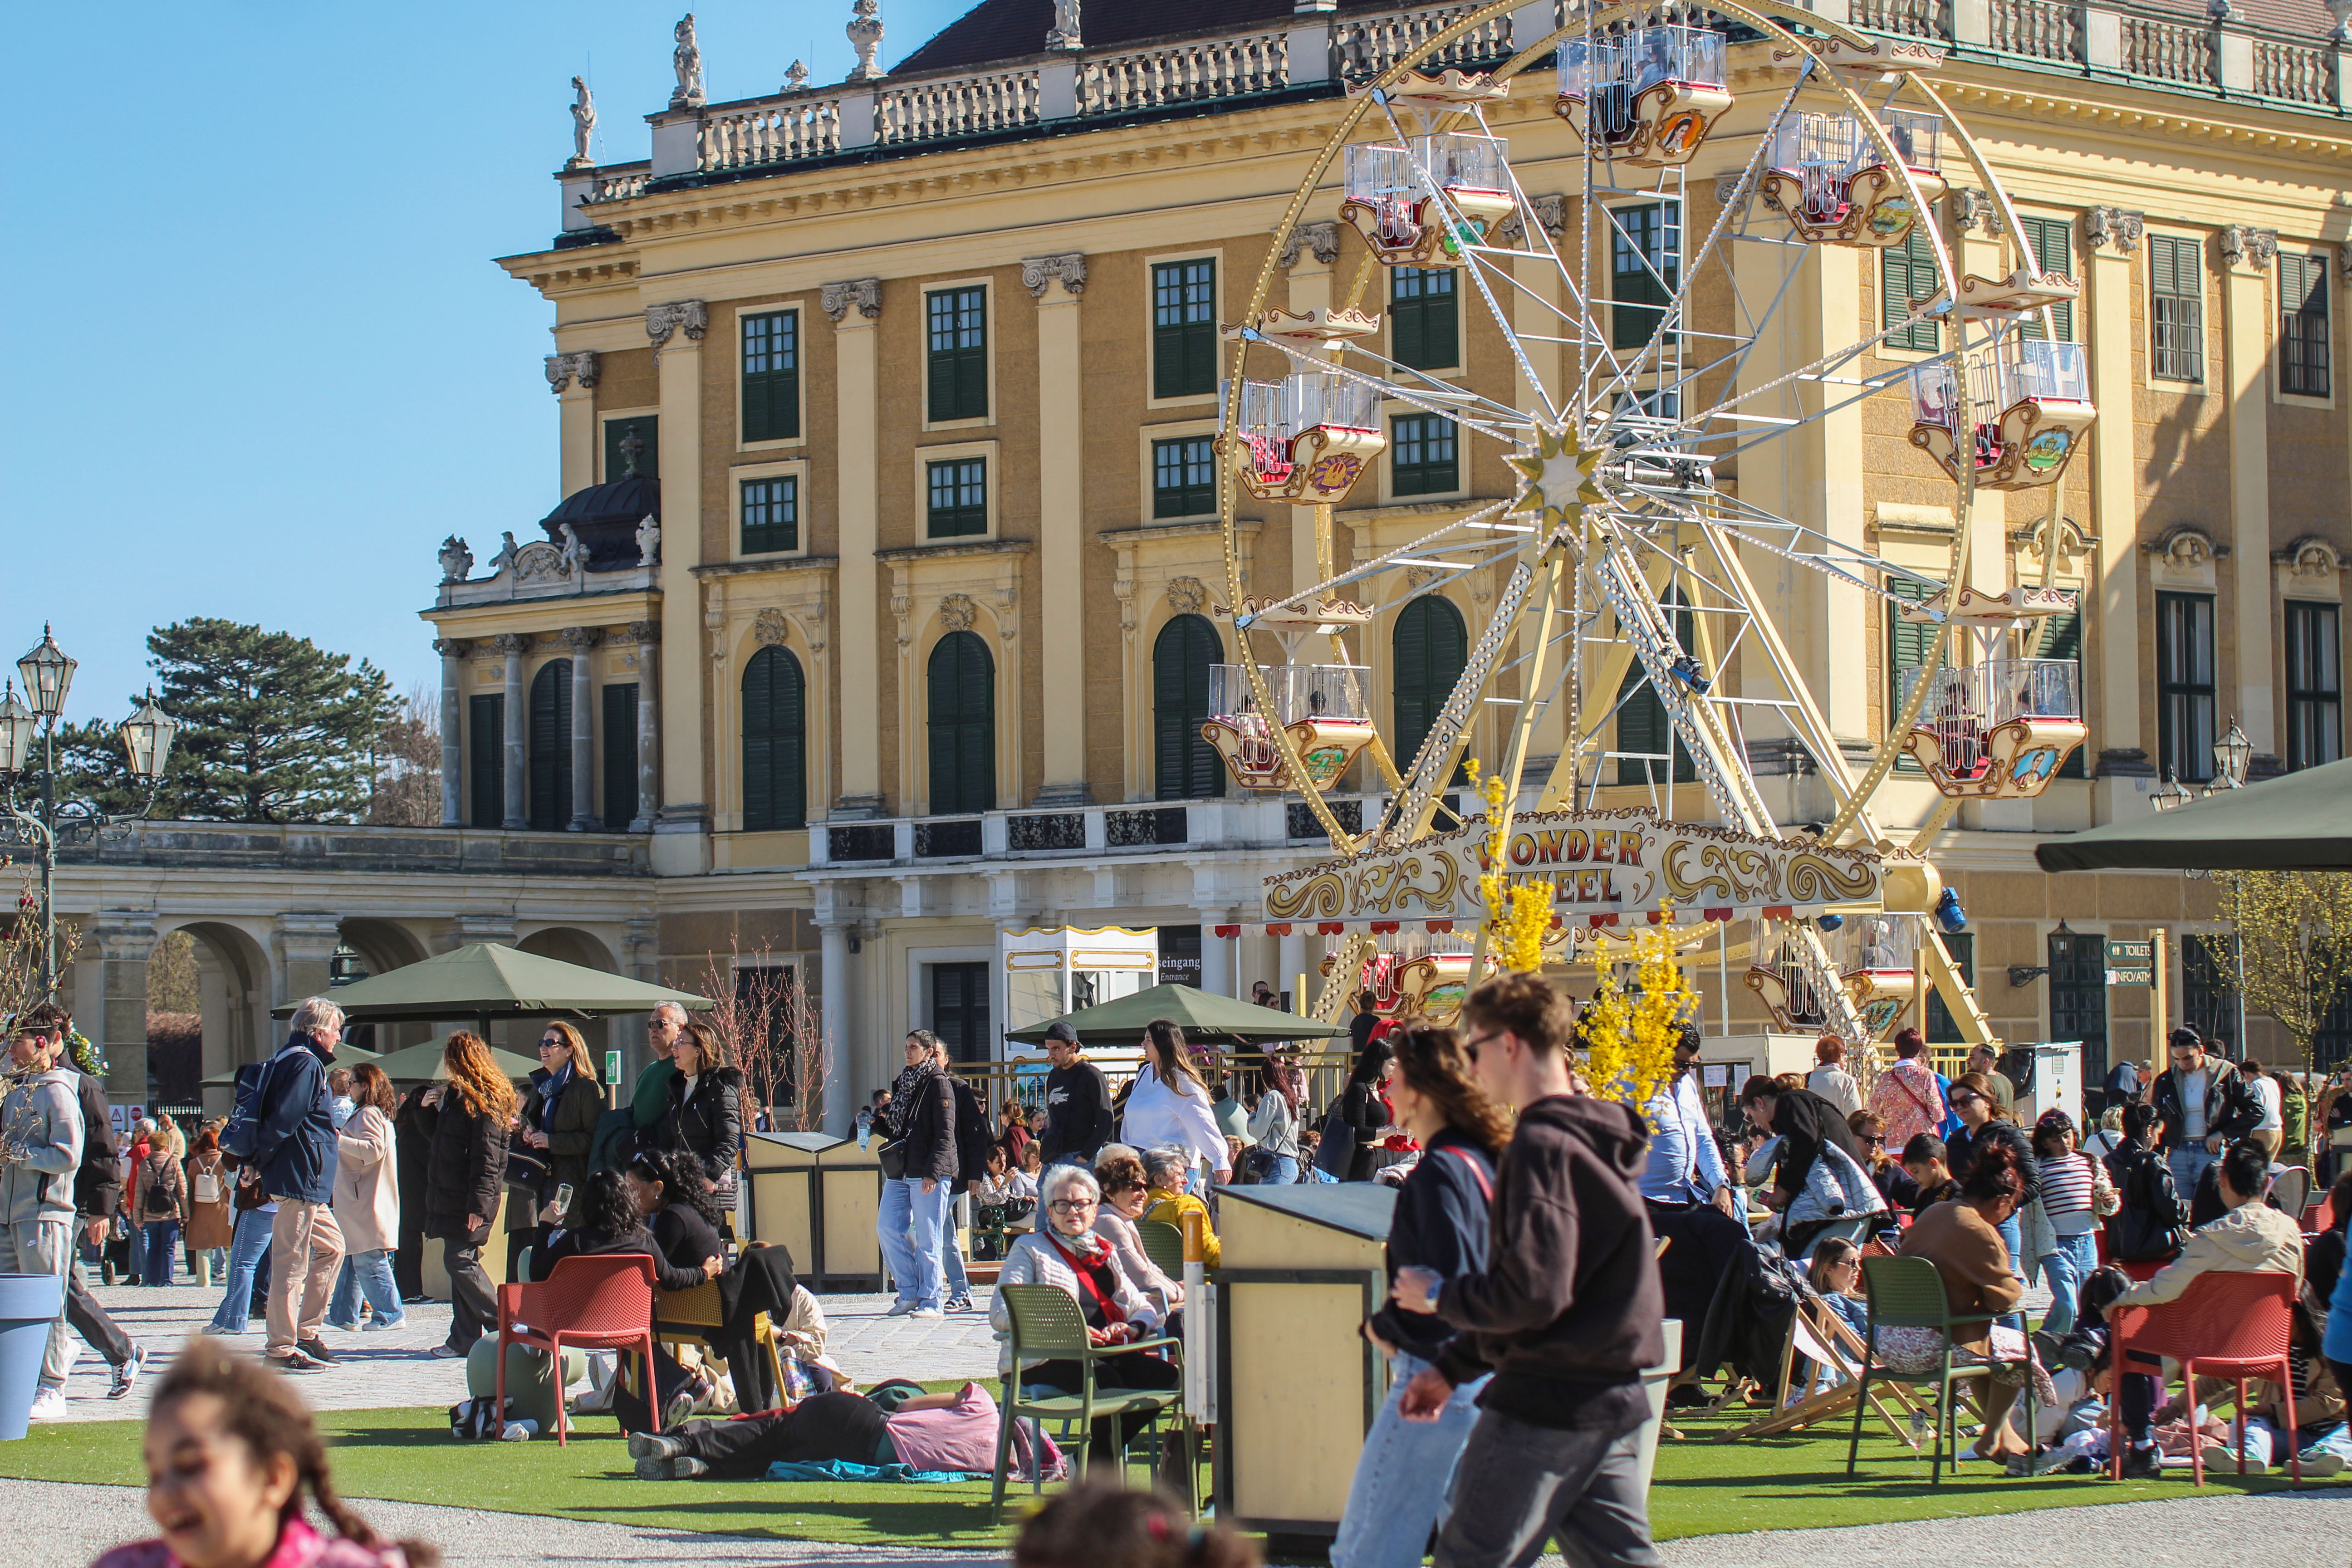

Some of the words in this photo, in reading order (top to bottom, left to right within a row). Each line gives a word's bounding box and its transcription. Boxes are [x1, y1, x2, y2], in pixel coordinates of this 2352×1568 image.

[1471, 829, 1643, 873] WONDER
[2124, 945, 2151, 956] TOILETS
[1161, 973, 1189, 981] Entrance
[2117, 971, 2151, 982] NFO/ATM
